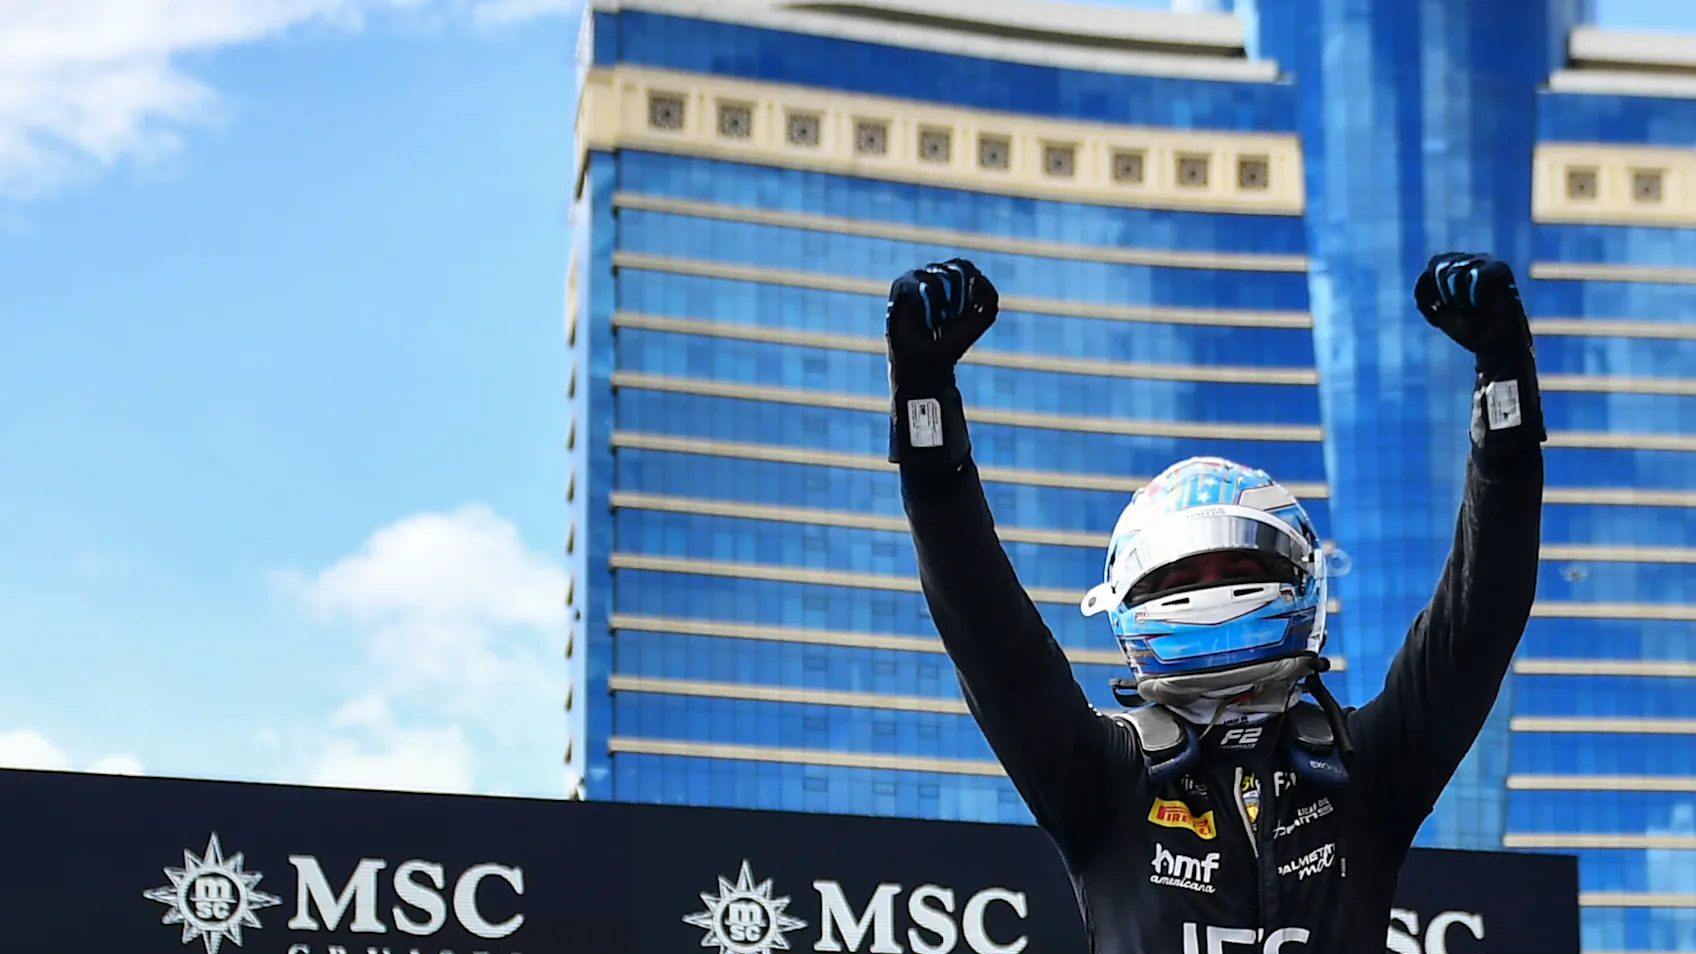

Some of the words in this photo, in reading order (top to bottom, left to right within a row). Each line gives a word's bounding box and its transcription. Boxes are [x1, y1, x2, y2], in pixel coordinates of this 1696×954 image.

[1219, 727, 1263, 745] F2
[1151, 842, 1221, 883] hmf
[287, 854, 525, 939] MSC
[1149, 874, 1216, 894] americana
